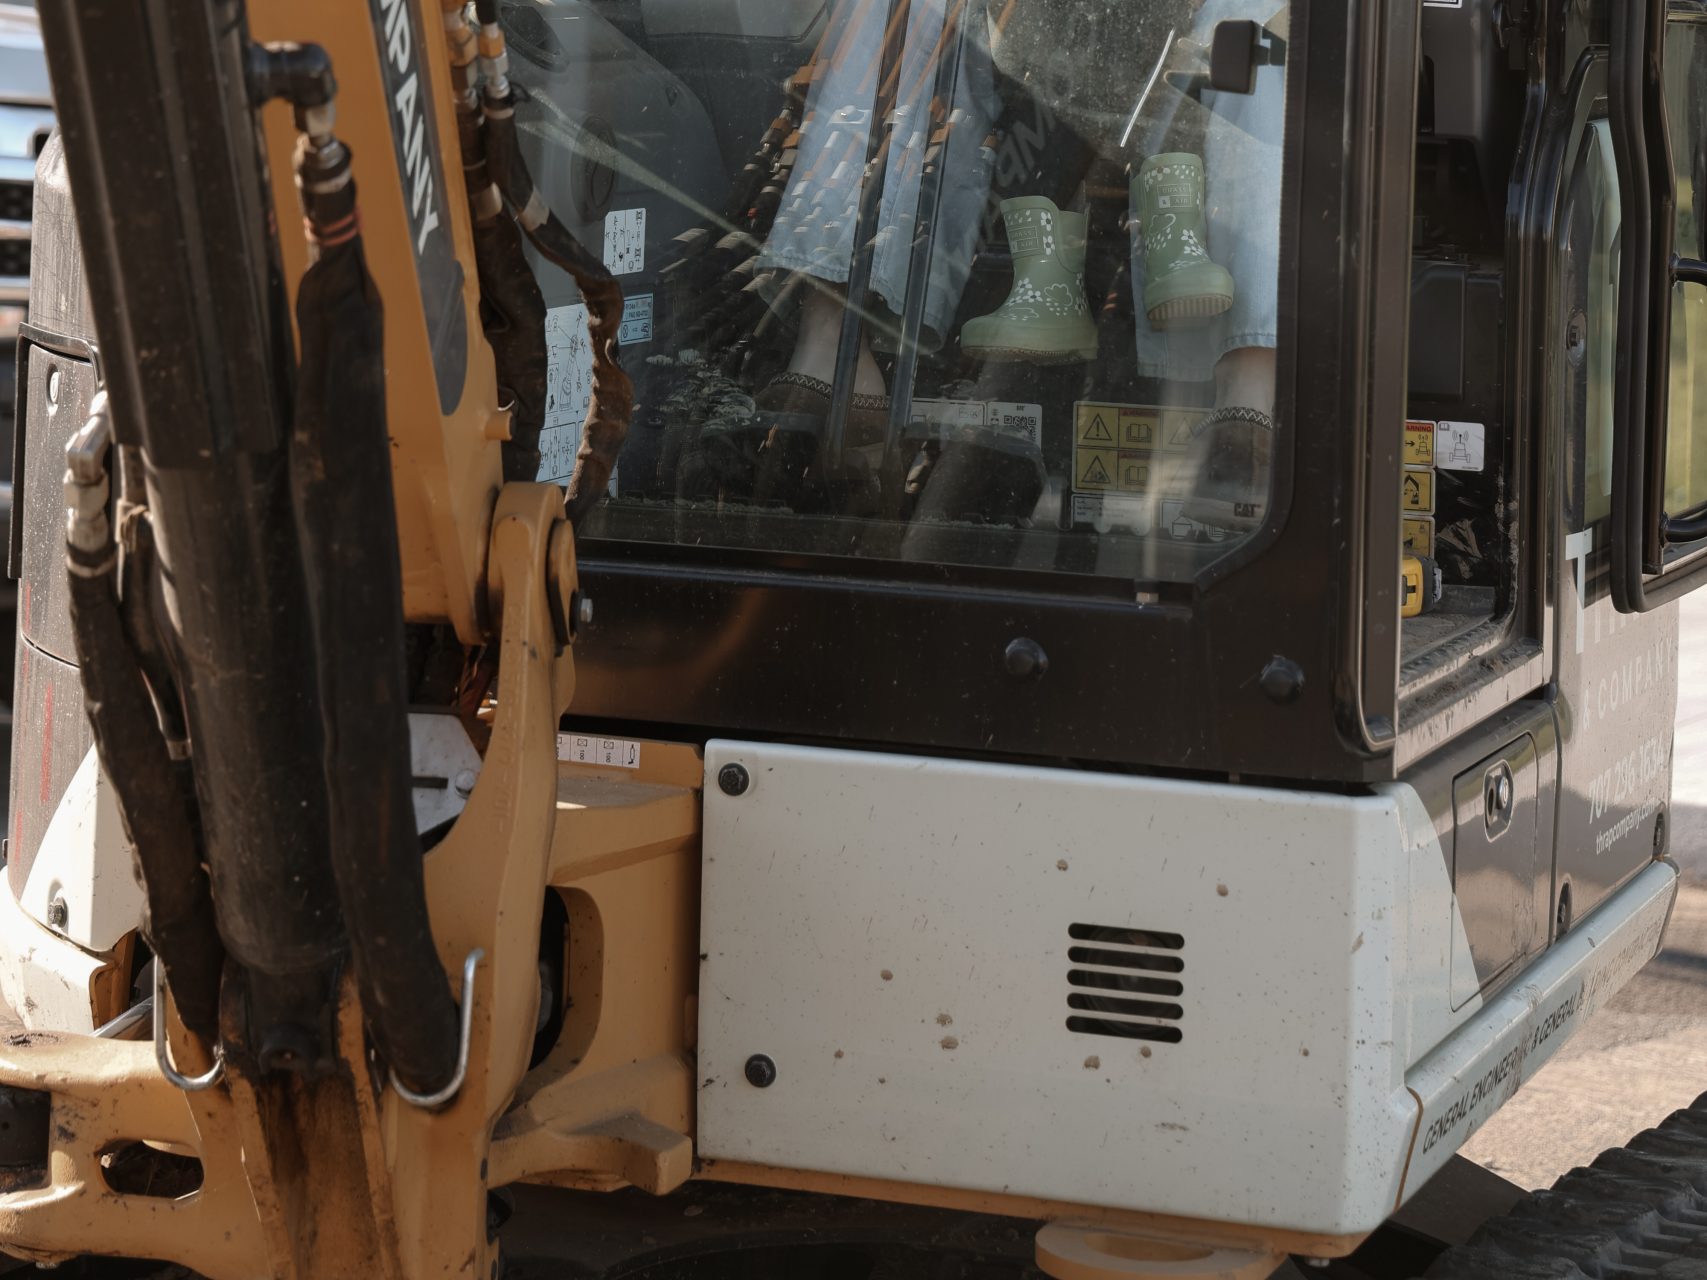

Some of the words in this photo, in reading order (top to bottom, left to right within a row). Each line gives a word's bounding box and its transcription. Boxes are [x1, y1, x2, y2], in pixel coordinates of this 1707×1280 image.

[1405, 425, 1431, 433] ARNING
[1234, 503, 1255, 518] CAT
[1598, 635, 1672, 720] COMPANY
[1588, 767, 1612, 824] 707
[1423, 1090, 1470, 1154] GENERAL
[1539, 991, 1577, 1045] GENERAL
